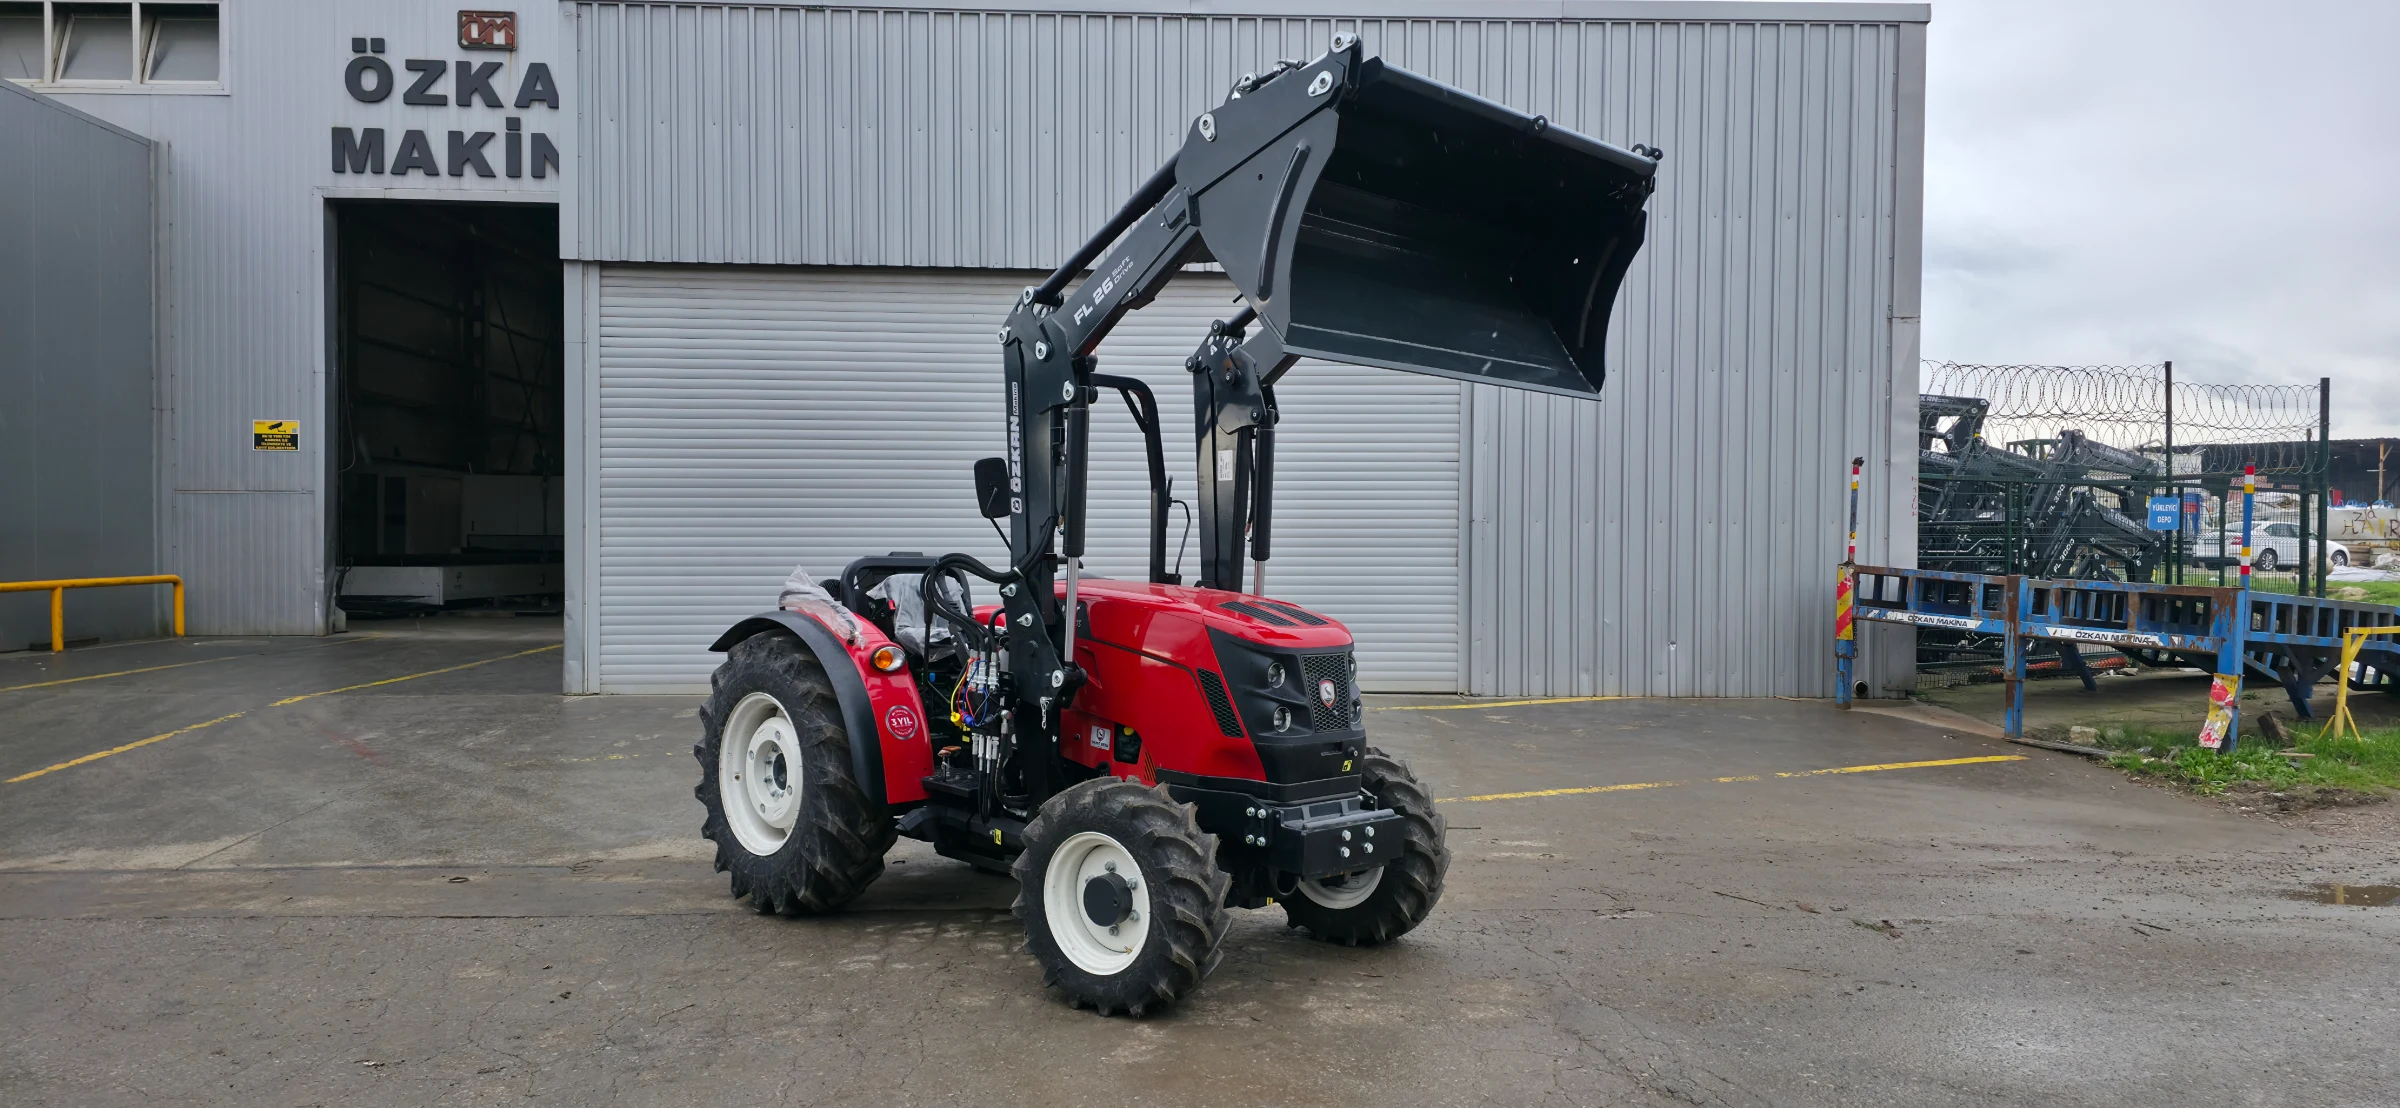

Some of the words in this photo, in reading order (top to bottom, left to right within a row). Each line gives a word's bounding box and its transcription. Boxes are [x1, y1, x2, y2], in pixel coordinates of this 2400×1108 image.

[345, 38, 559, 108] ÖZKA
[1112, 256, 1130, 277] Soft
[1114, 261, 1134, 284] Drive
[1074, 304, 1093, 326] FL
[1093, 277, 1113, 305] 26
[1010, 416, 1021, 493] ÖZKAN
[2075, 630, 2109, 641] ÖZKAN
[891, 718, 897, 726] 3
[897, 716, 913, 725] YIL
